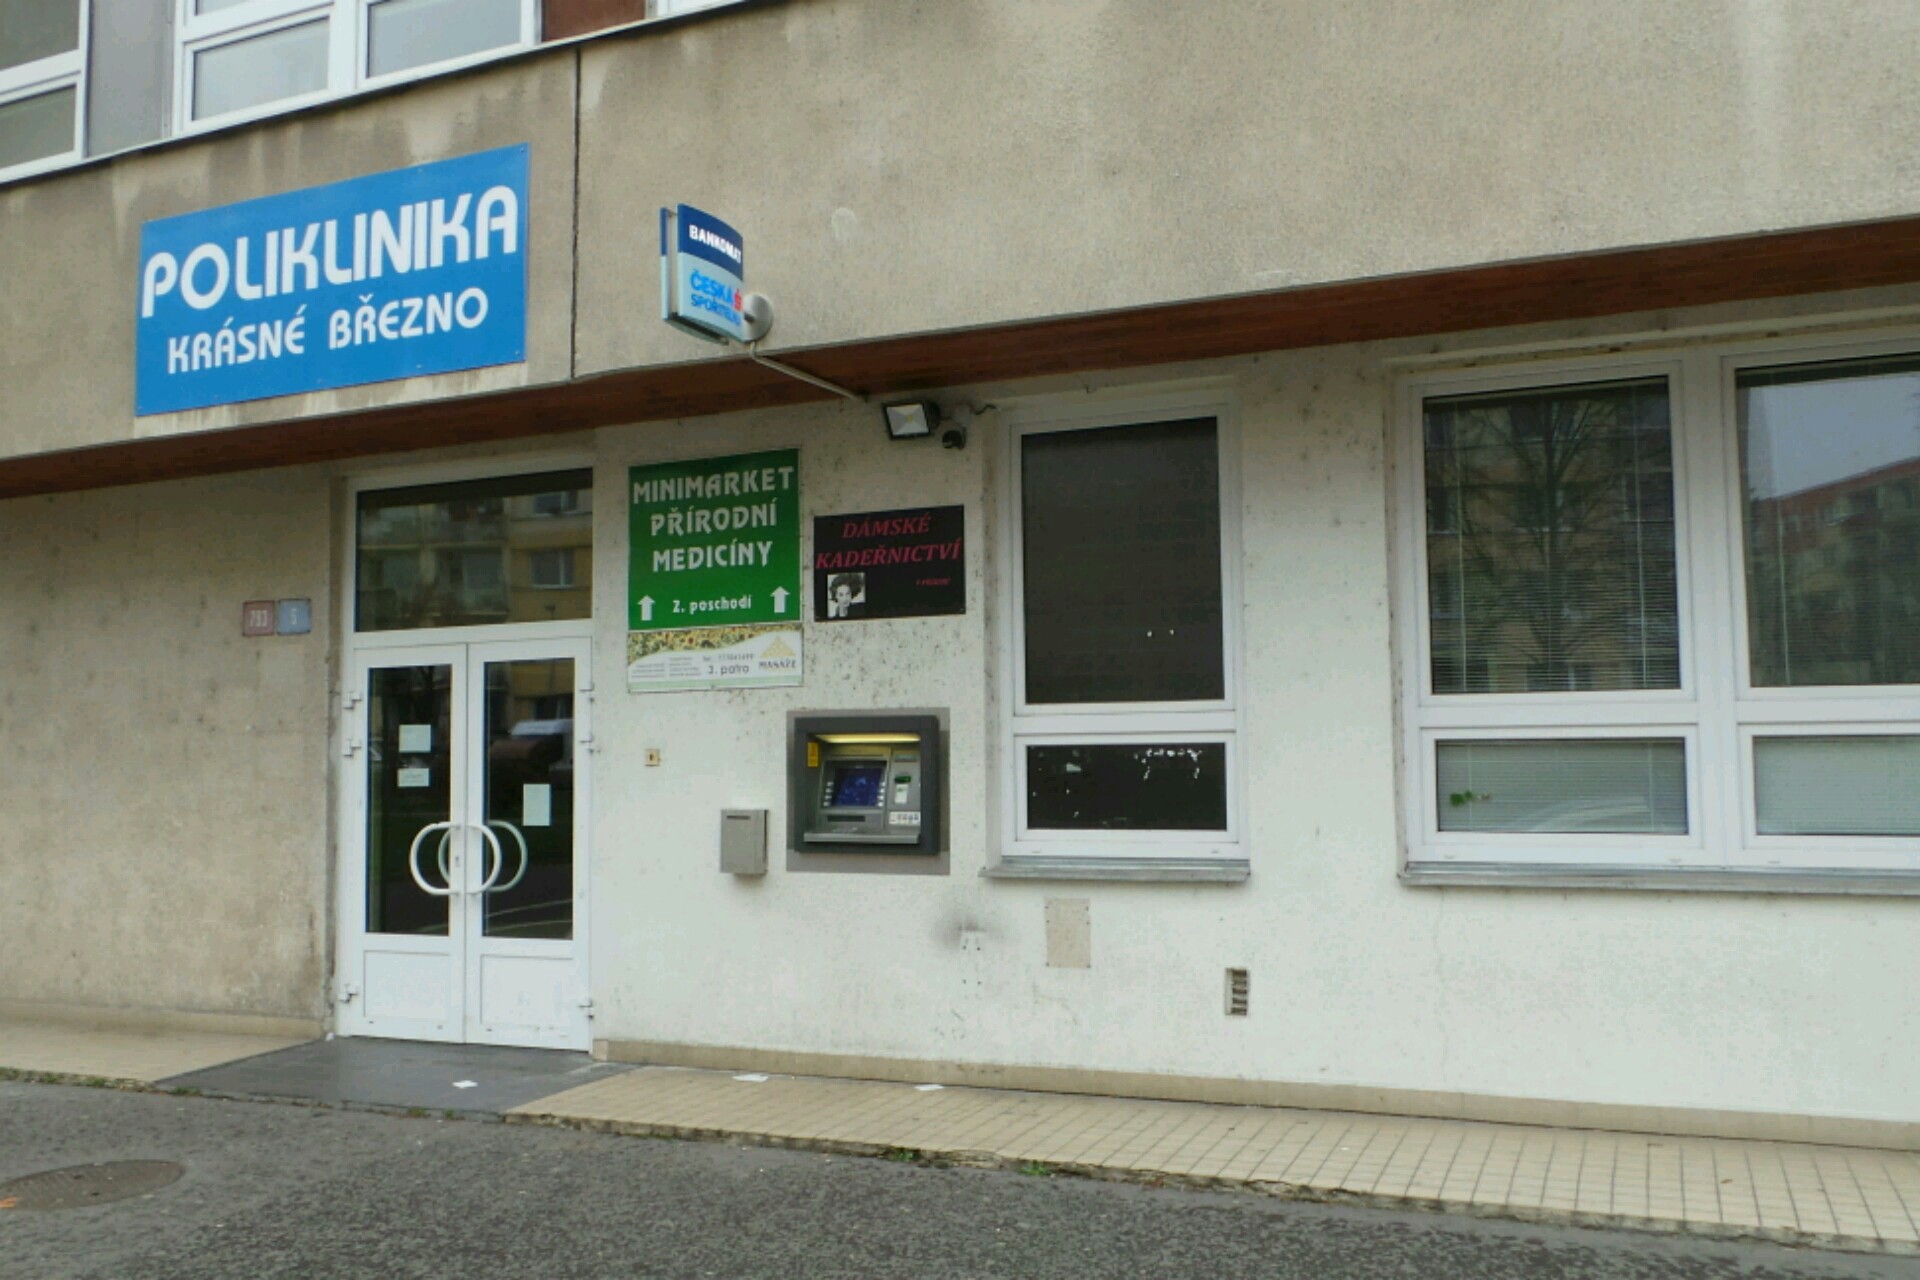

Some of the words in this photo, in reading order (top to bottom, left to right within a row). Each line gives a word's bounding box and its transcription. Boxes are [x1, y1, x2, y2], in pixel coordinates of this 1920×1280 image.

[142, 185, 518, 318] POLIKLINIKA
[168, 305, 306, 374] KRÁSNÉ
[329, 288, 488, 349] BŘEZNO
[633, 466, 794, 504] MINIMARKET
[651, 497, 777, 536] PŘÍRODNÍ
[842, 512, 932, 538] DÁMSKÉ
[653, 538, 773, 572] MEDICÍNY
[815, 538, 962, 569] KADEŘNICTVÍ
[672, 599, 685, 613] 2.
[689, 594, 752, 615] poschodí
[720, 664, 750, 677] patro
